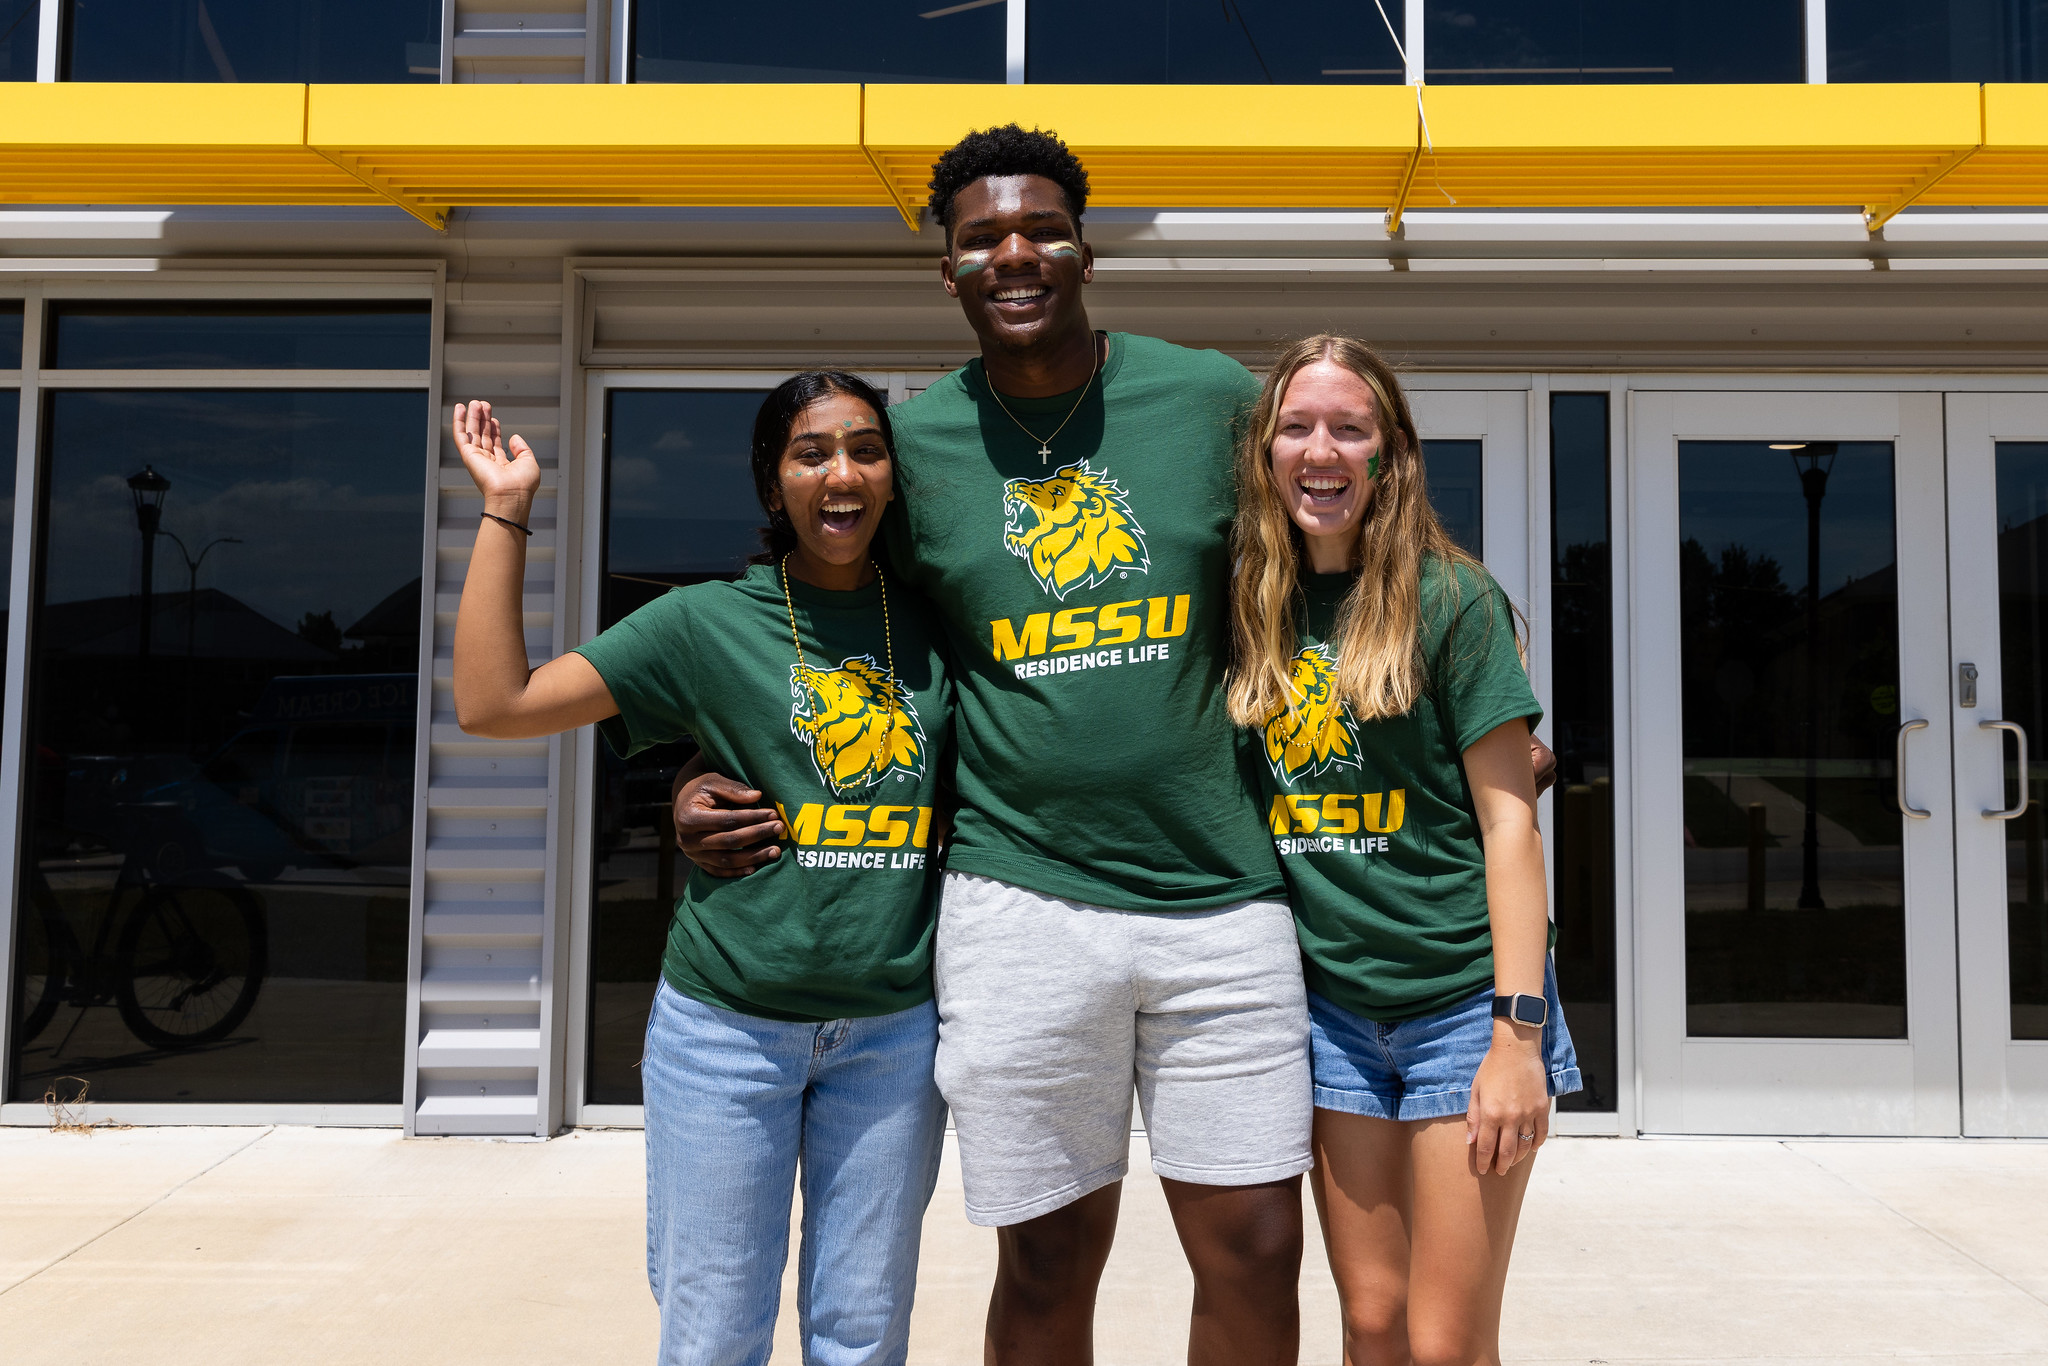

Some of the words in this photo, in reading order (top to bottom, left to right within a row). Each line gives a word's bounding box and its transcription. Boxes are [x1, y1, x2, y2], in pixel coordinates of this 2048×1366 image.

[989, 594, 1190, 662] MSSU
[1014, 648, 1122, 680] RESIDENCE
[1129, 643, 1169, 664] LIFE
[797, 848, 885, 869] ESIDENCE
[890, 853, 925, 870] LIFE
[1275, 836, 1344, 855] SIDENCE
[1350, 837, 1389, 854] LIFE
